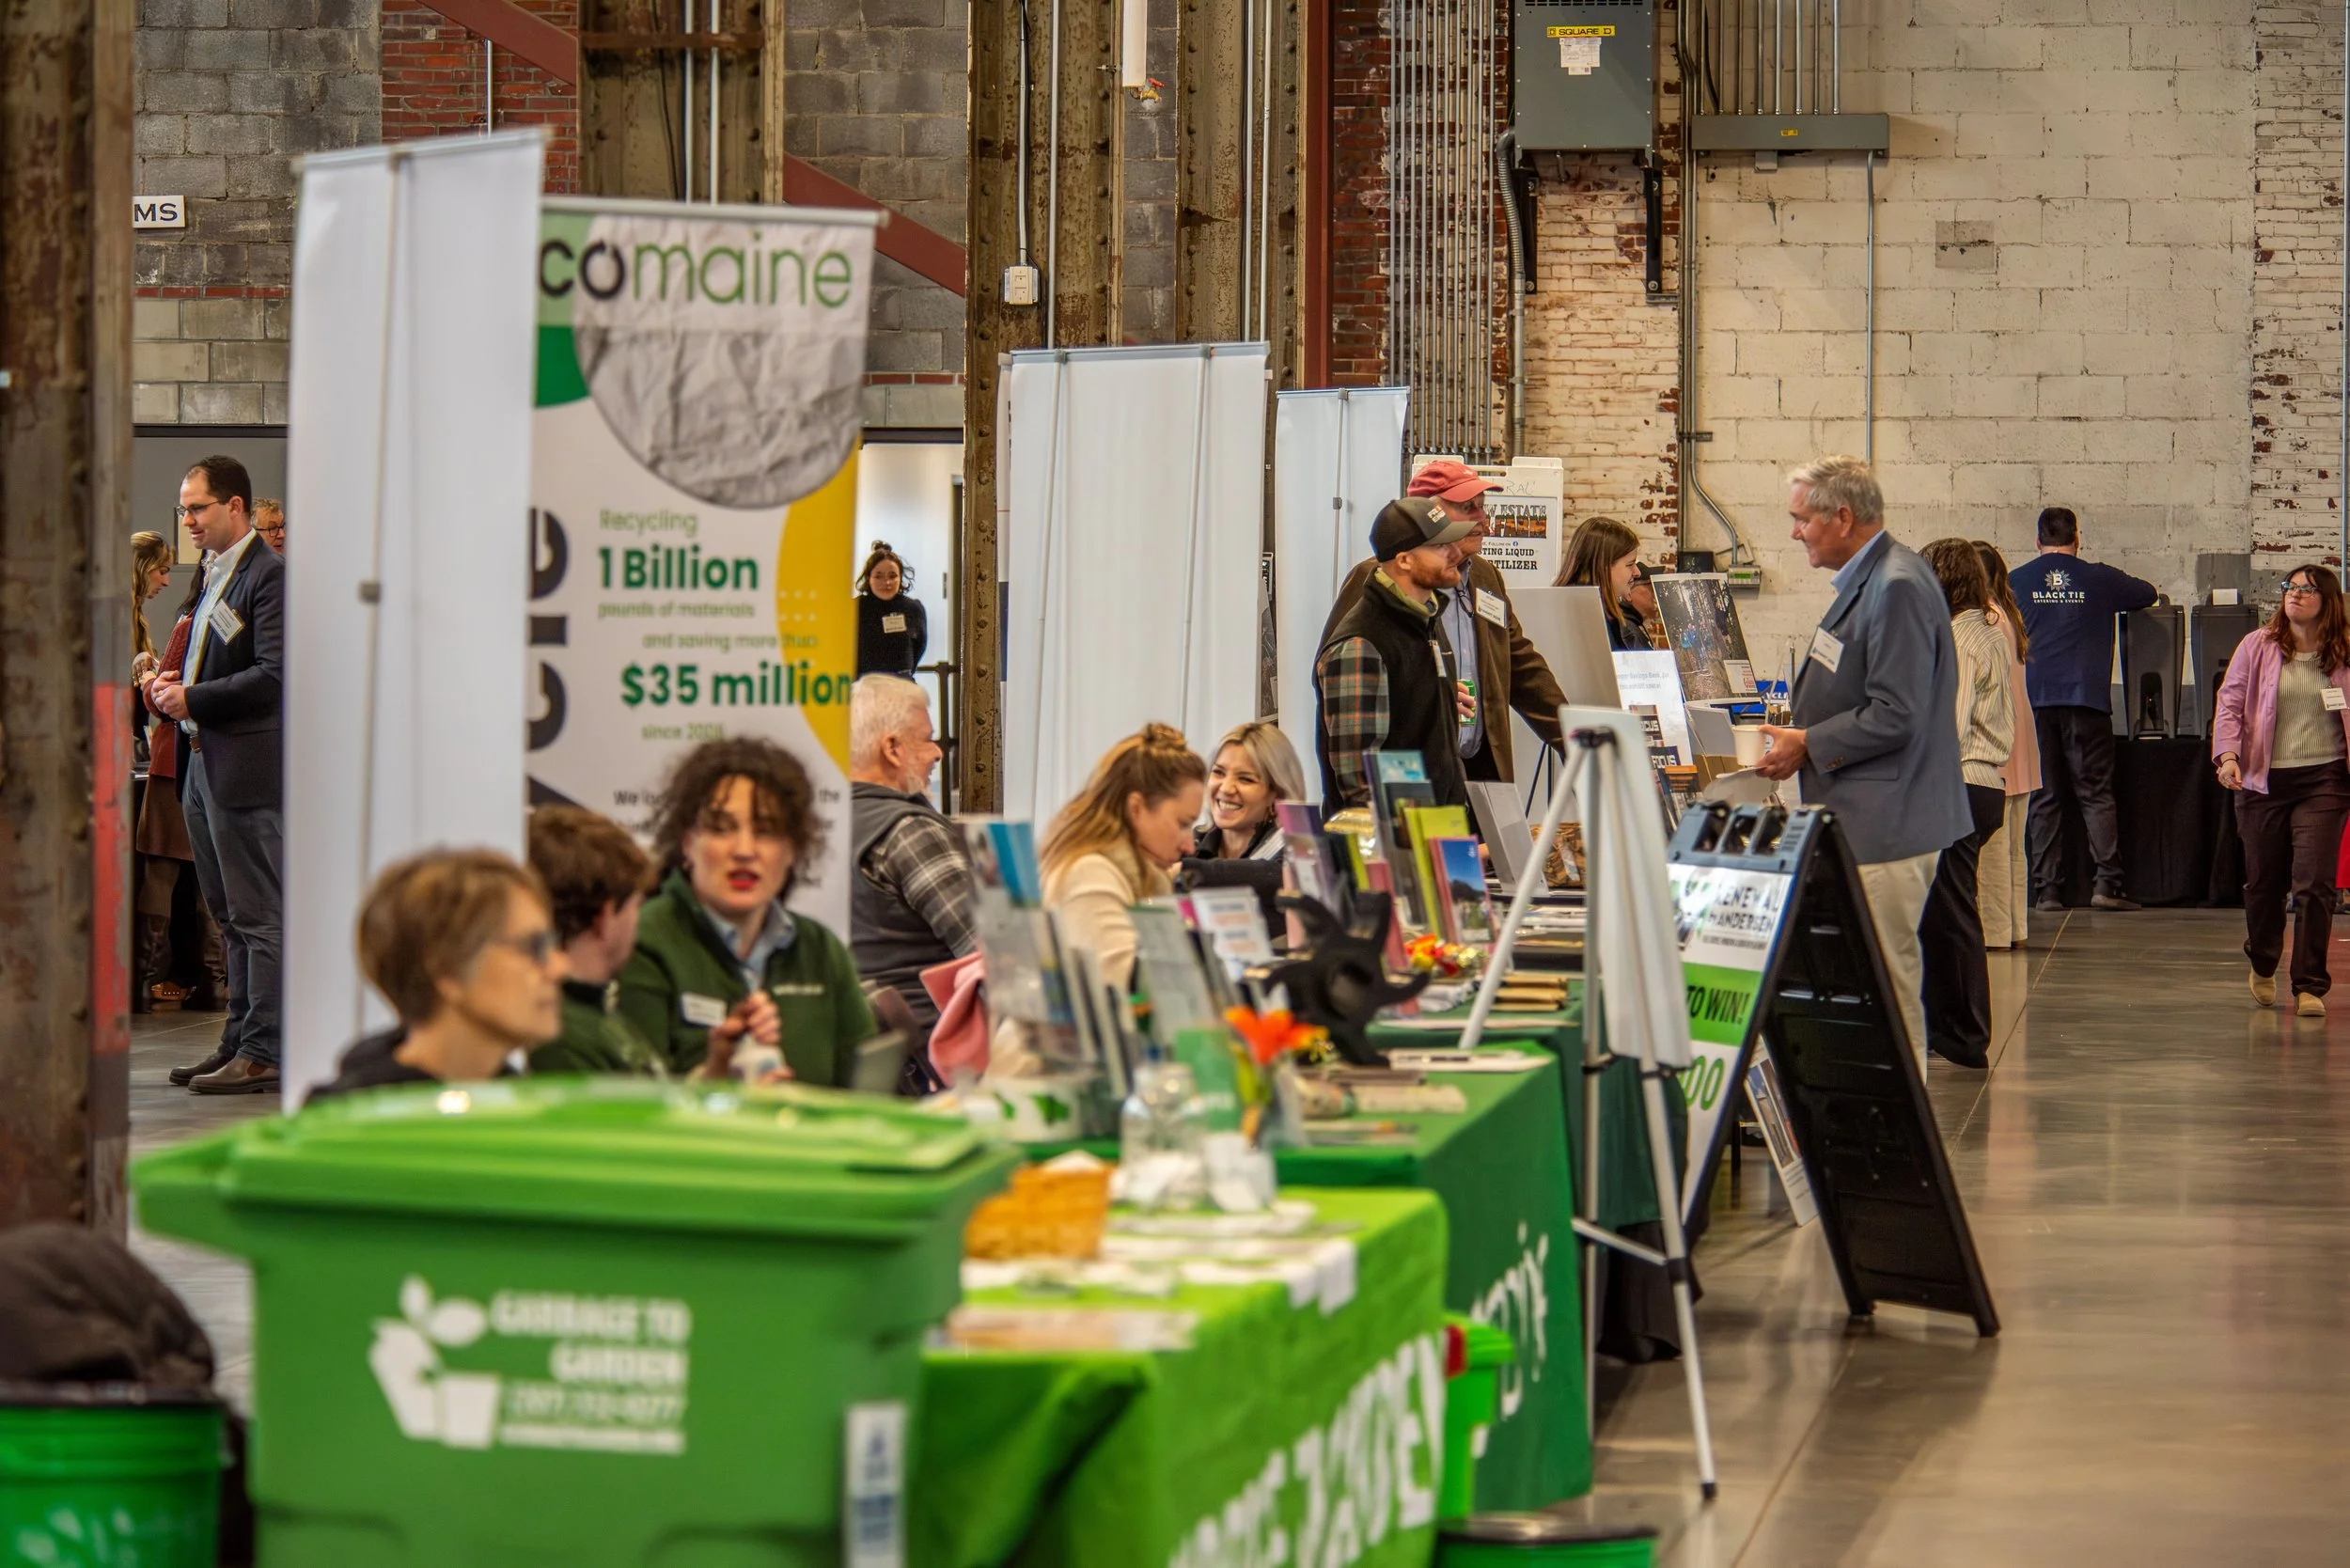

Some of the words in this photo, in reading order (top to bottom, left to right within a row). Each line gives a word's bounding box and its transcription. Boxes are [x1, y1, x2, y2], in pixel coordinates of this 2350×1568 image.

[133, 203, 178, 222] MS
[539, 232, 852, 308] comaine
[600, 509, 698, 538] Recycling
[599, 547, 612, 588] 1
[623, 543, 759, 589] Billion
[2052, 573, 2063, 585] B
[642, 634, 673, 649] and
[677, 635, 731, 654] saving
[619, 661, 699, 709] $35
[712, 660, 852, 706] million
[1703, 987, 1751, 1025] WIN!
